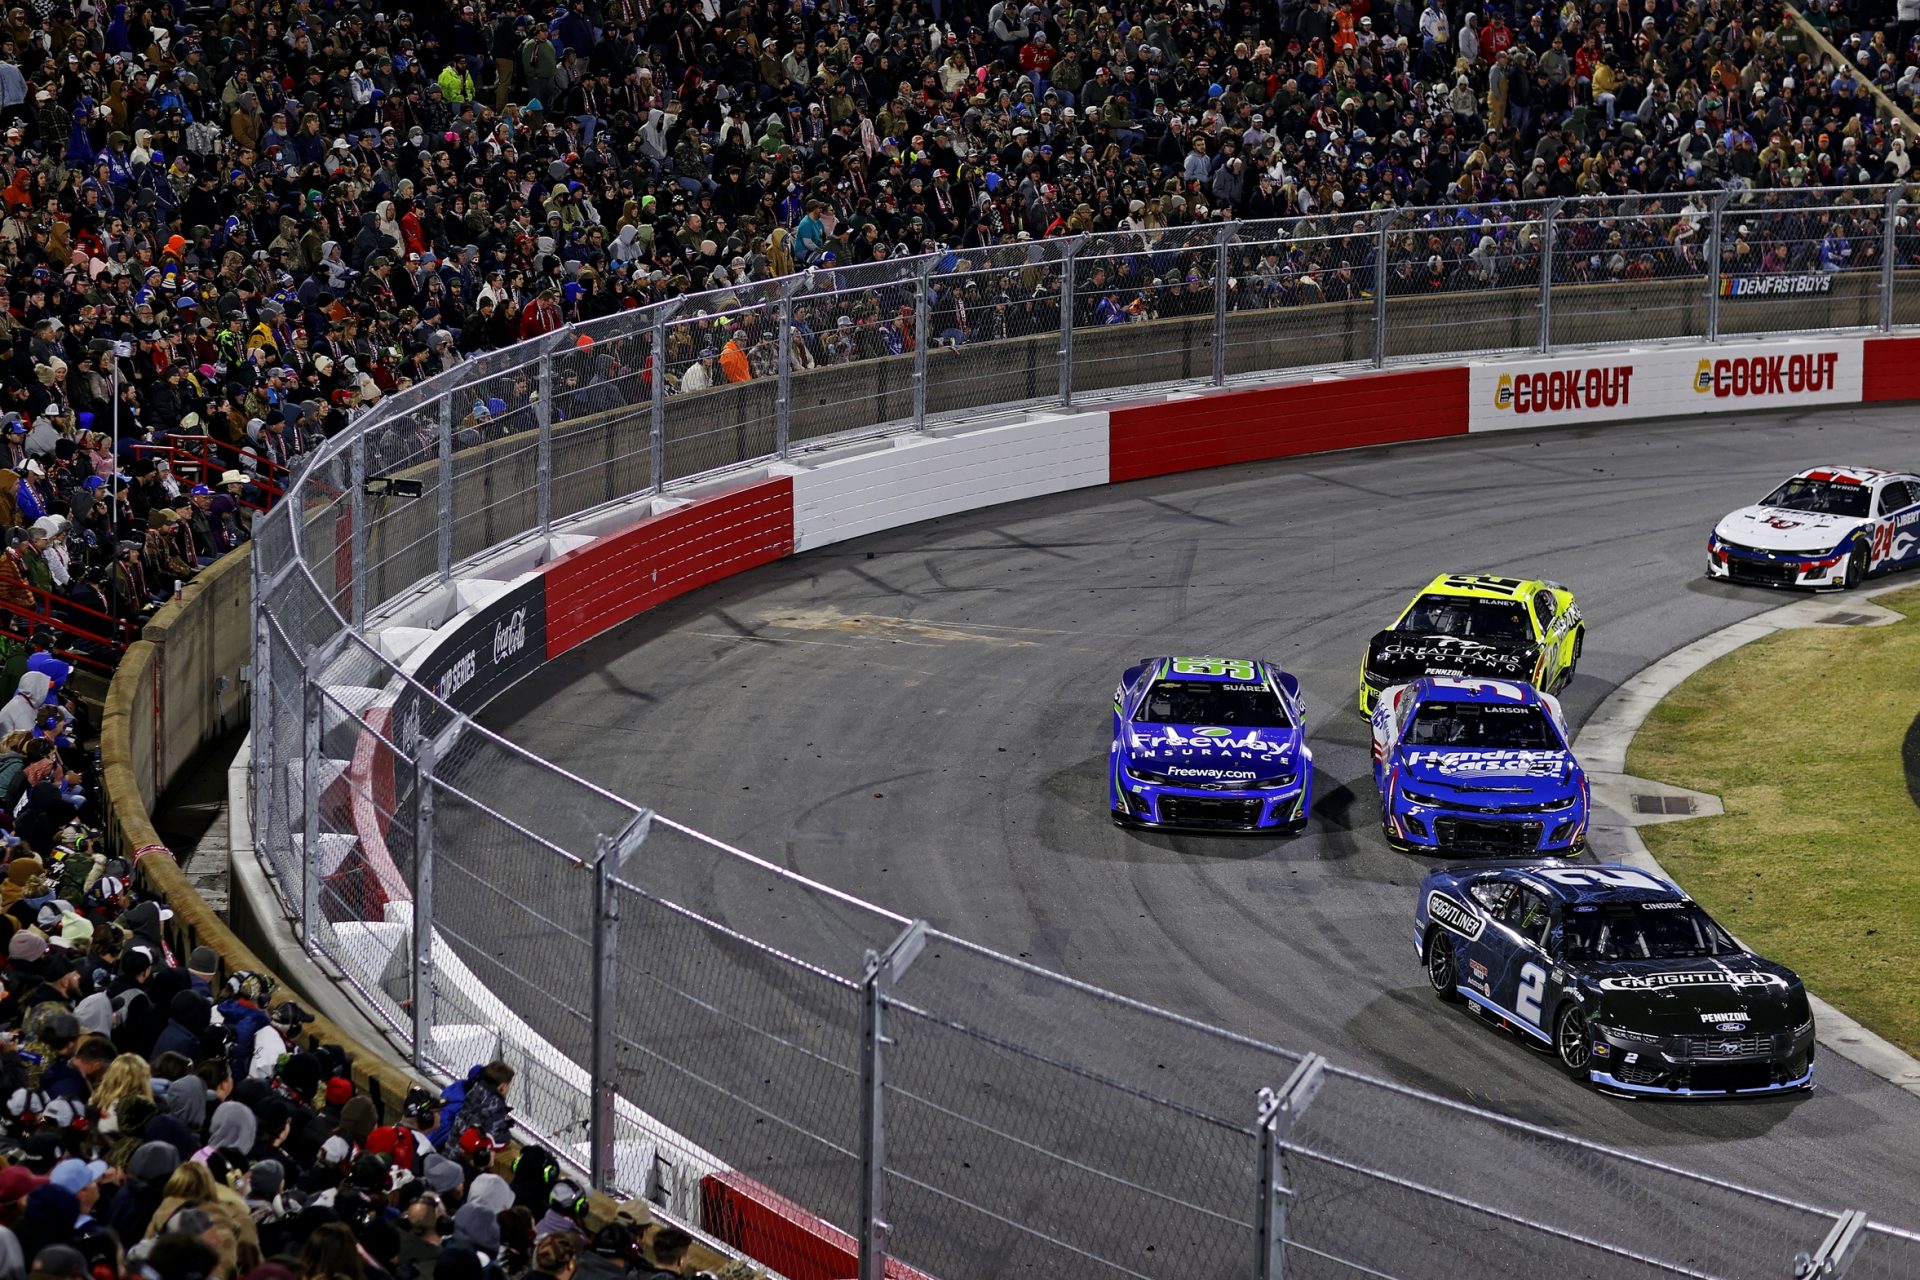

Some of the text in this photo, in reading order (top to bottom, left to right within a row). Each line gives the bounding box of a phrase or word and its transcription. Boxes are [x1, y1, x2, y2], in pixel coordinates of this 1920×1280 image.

[1713, 352, 1838, 398] COOK OUT
[1513, 366, 1633, 414] COOK OUT
[1830, 484, 1860, 492] BYRON
[1872, 521, 1896, 562] 24
[1478, 598, 1517, 608] BLANEY
[1384, 644, 1521, 664] GREAT LAKES
[452, 649, 476, 693] SERIES
[1424, 667, 1464, 678] PENNZOIL
[1222, 682, 1270, 692] SUÁREZ
[1484, 706, 1530, 714] LARSON
[1131, 732, 1289, 755] Freeway
[1131, 749, 1290, 765] INSURANCE
[1168, 766, 1257, 780] Freeway.com
[1641, 902, 1686, 911] CINDRIC
[1430, 896, 1480, 936] FREIGHTLINER
[1620, 972, 1765, 988] FREIGHTLINER
[1516, 961, 1547, 1027] 2
[1468, 999, 1482, 1012] FORD
[1700, 1011, 1751, 1024] PENNZOIL
[1720, 1023, 1743, 1032] Ford
[1623, 1051, 1639, 1065] 2
